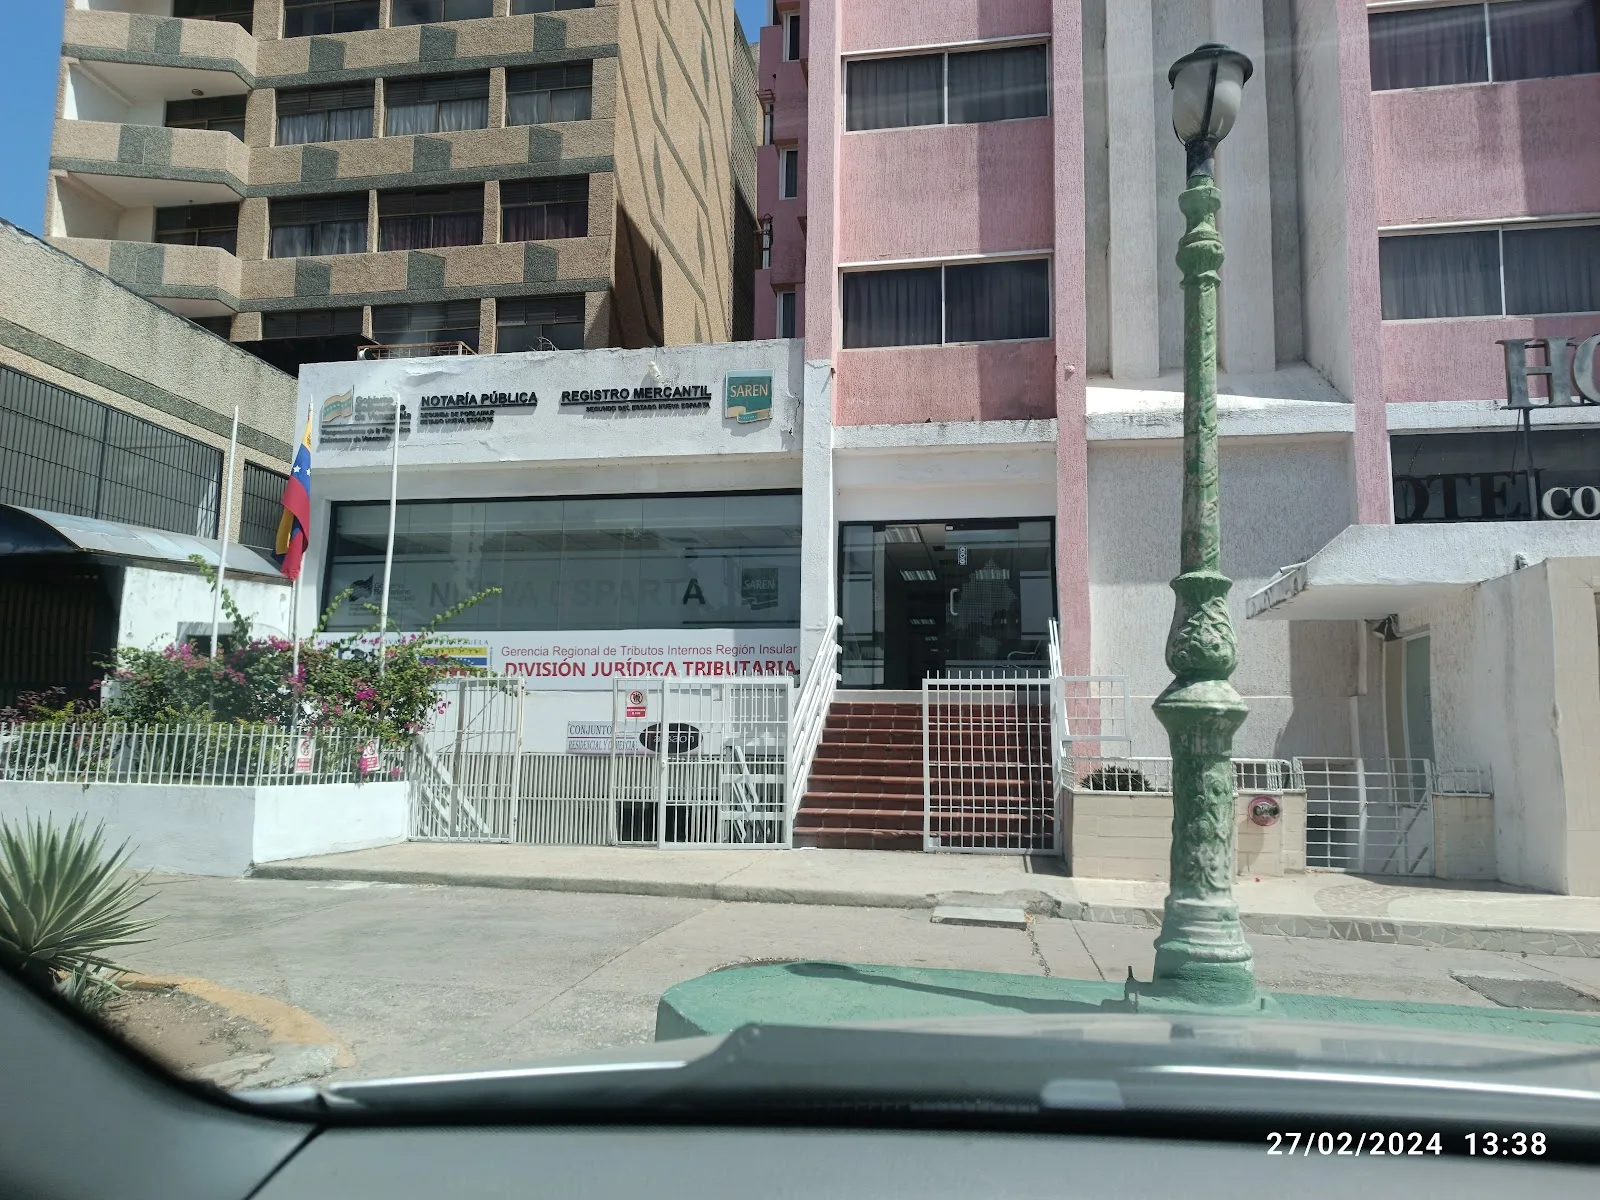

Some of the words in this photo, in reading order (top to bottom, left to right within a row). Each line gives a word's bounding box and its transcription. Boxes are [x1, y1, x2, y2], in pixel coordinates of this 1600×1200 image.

[421, 391, 478, 407] NOTARÍA
[480, 390, 538, 404] PÚBLICA
[562, 387, 630, 402] REGISTRO
[633, 385, 712, 399] MERCANTIL
[730, 384, 768, 398] SAREN
[744, 579, 776, 590] SAREN
[501, 646, 549, 657] Gerencia
[552, 645, 600, 659] Regional
[603, 645, 617, 656] de
[620, 645, 664, 656] Tributos
[667, 644, 712, 655] Internos
[716, 643, 756, 657] Región
[759, 643, 797, 655] Insular
[505, 657, 586, 677] DIVISIÓN
[591, 657, 677, 677] JURÍDICA
[682, 660, 797, 677] TRIBUTARIA
[569, 725, 612, 735] CONJUNTO
